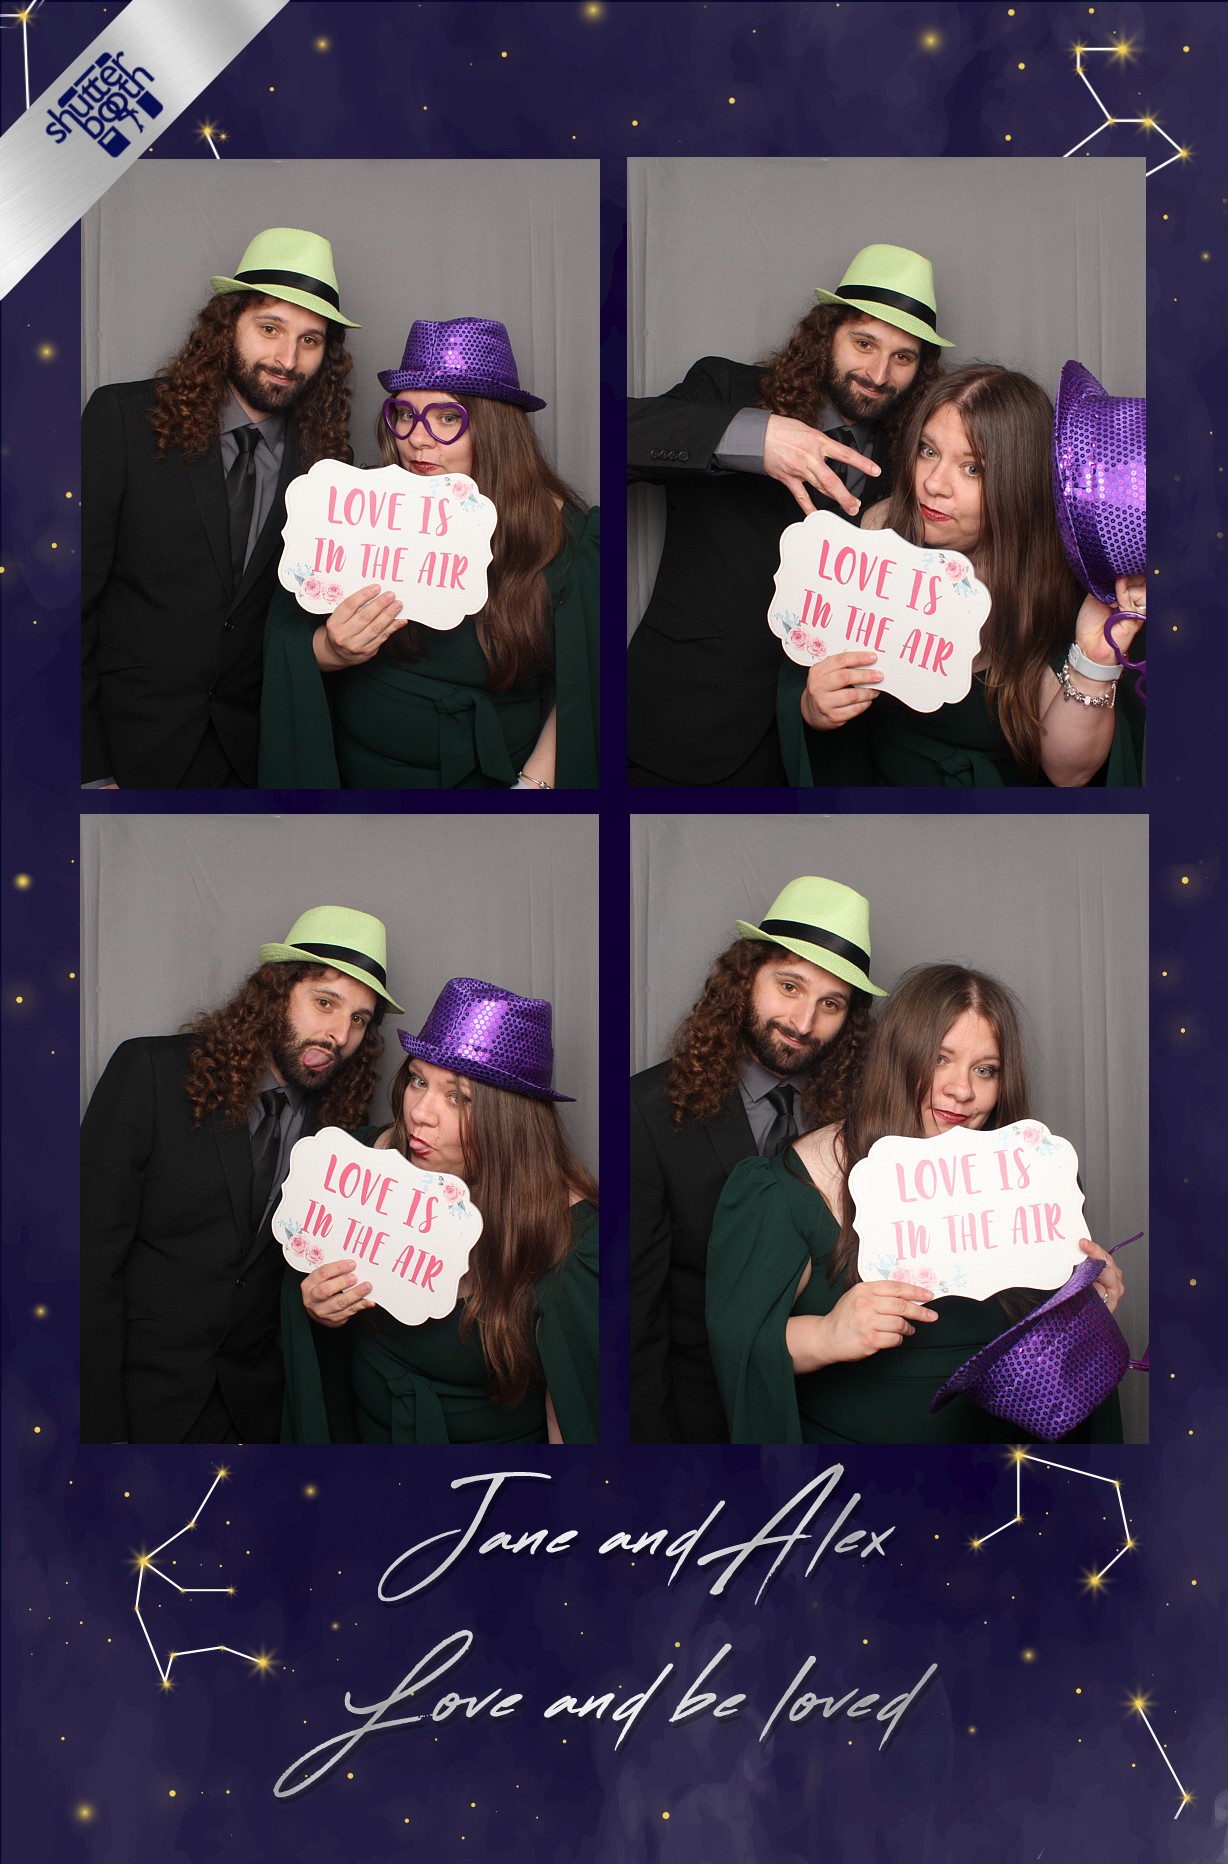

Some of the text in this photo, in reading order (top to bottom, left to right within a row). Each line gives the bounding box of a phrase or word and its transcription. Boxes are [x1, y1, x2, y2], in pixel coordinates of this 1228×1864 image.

[327, 485, 453, 537] LOVE IS
[360, 543, 409, 583] THE
[417, 551, 469, 591] AIR
[818, 539, 943, 616] LOVE IS
[845, 604, 895, 653] THE
[899, 628, 954, 677] AIR
[323, 1154, 439, 1234] LOVE IS
[895, 1147, 1031, 1203] LOVE IS
[342, 1217, 391, 1266] THE
[391, 1244, 444, 1293] AIR
[942, 1209, 998, 1254] THE
[1011, 1202, 1066, 1245] AIR
